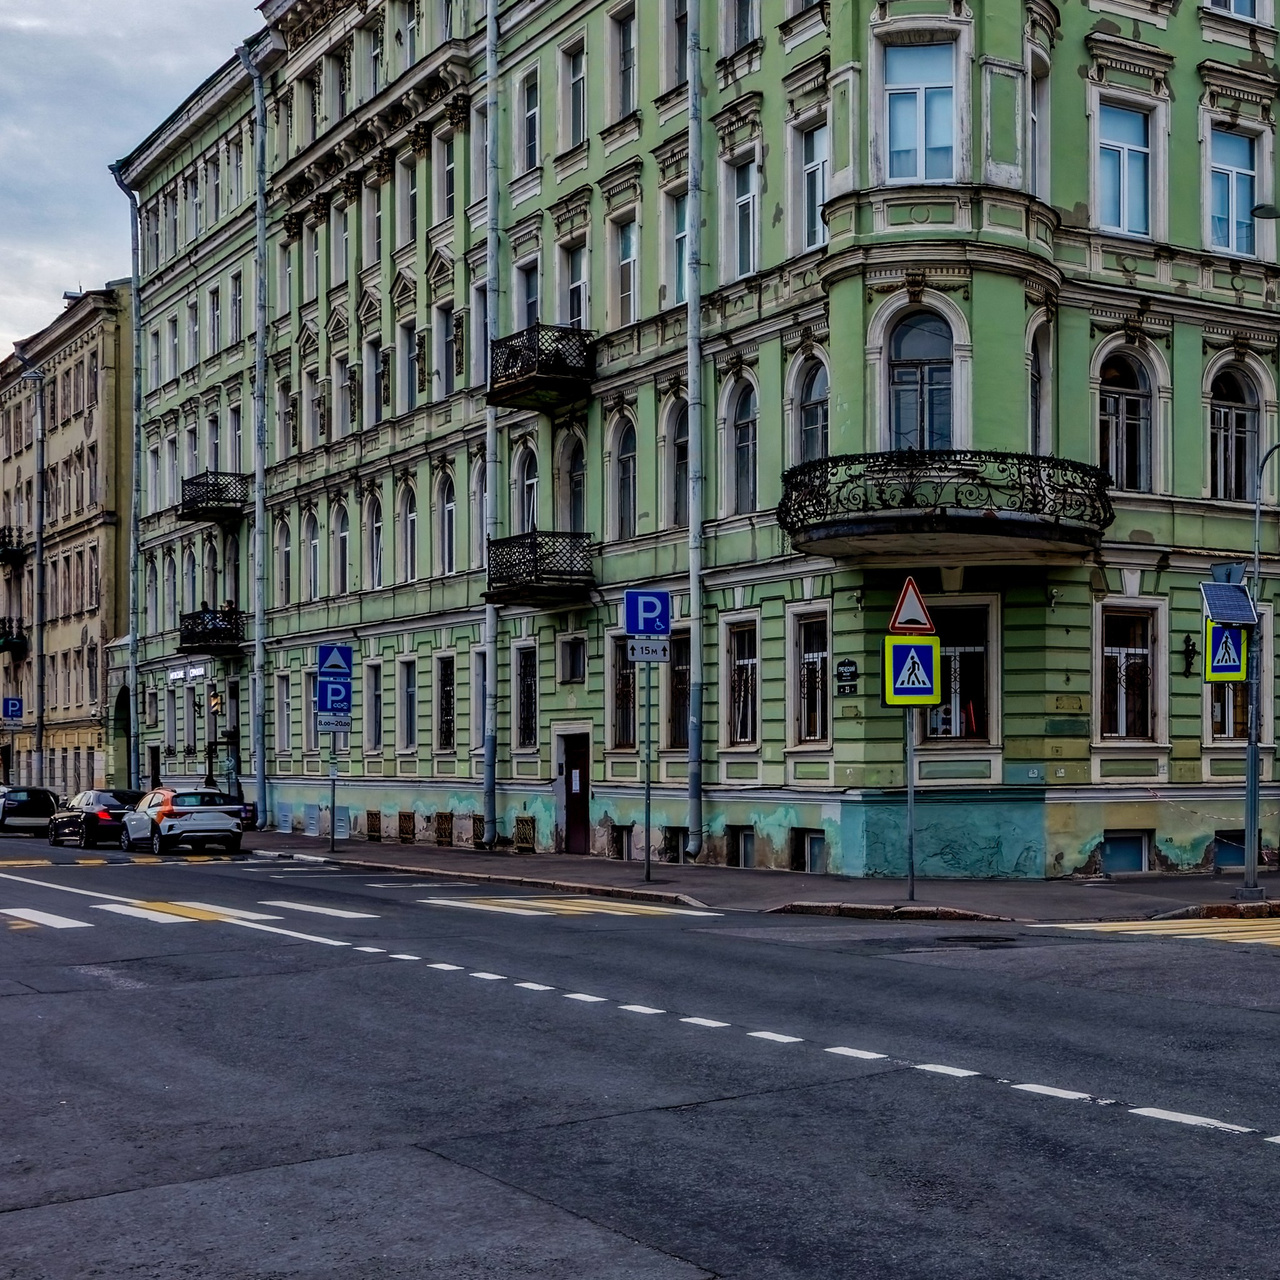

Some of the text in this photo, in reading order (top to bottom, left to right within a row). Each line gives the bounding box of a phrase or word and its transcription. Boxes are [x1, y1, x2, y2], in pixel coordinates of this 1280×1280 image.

[637, 595, 662, 630] P
[8, 700, 20, 716] P
[327, 684, 346, 709] P
